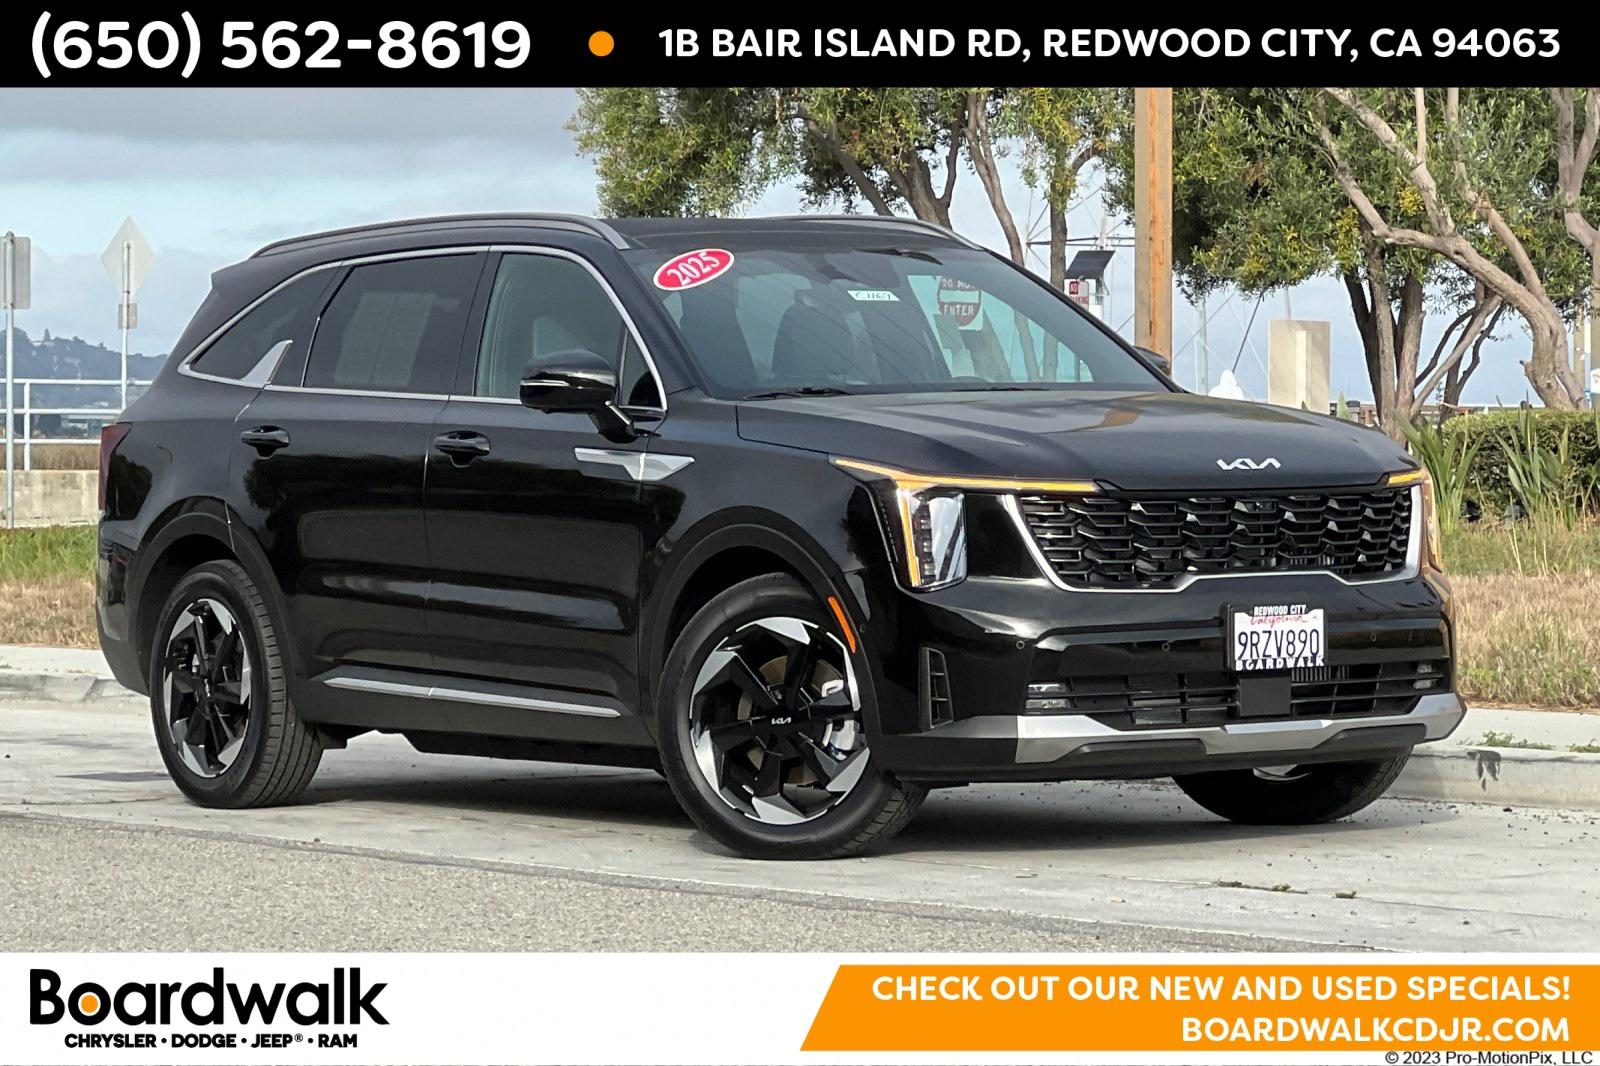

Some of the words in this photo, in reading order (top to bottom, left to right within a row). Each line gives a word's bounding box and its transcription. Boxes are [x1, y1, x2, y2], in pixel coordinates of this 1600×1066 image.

[667, 251, 720, 286] 2025
[1254, 606, 1288, 616] REDWOOD
[1290, 604, 1307, 615] CITY
[1250, 615, 1307, 628] California
[1238, 628, 1320, 661] 9RZV890
[1235, 656, 1325, 672] BOARDWALK
